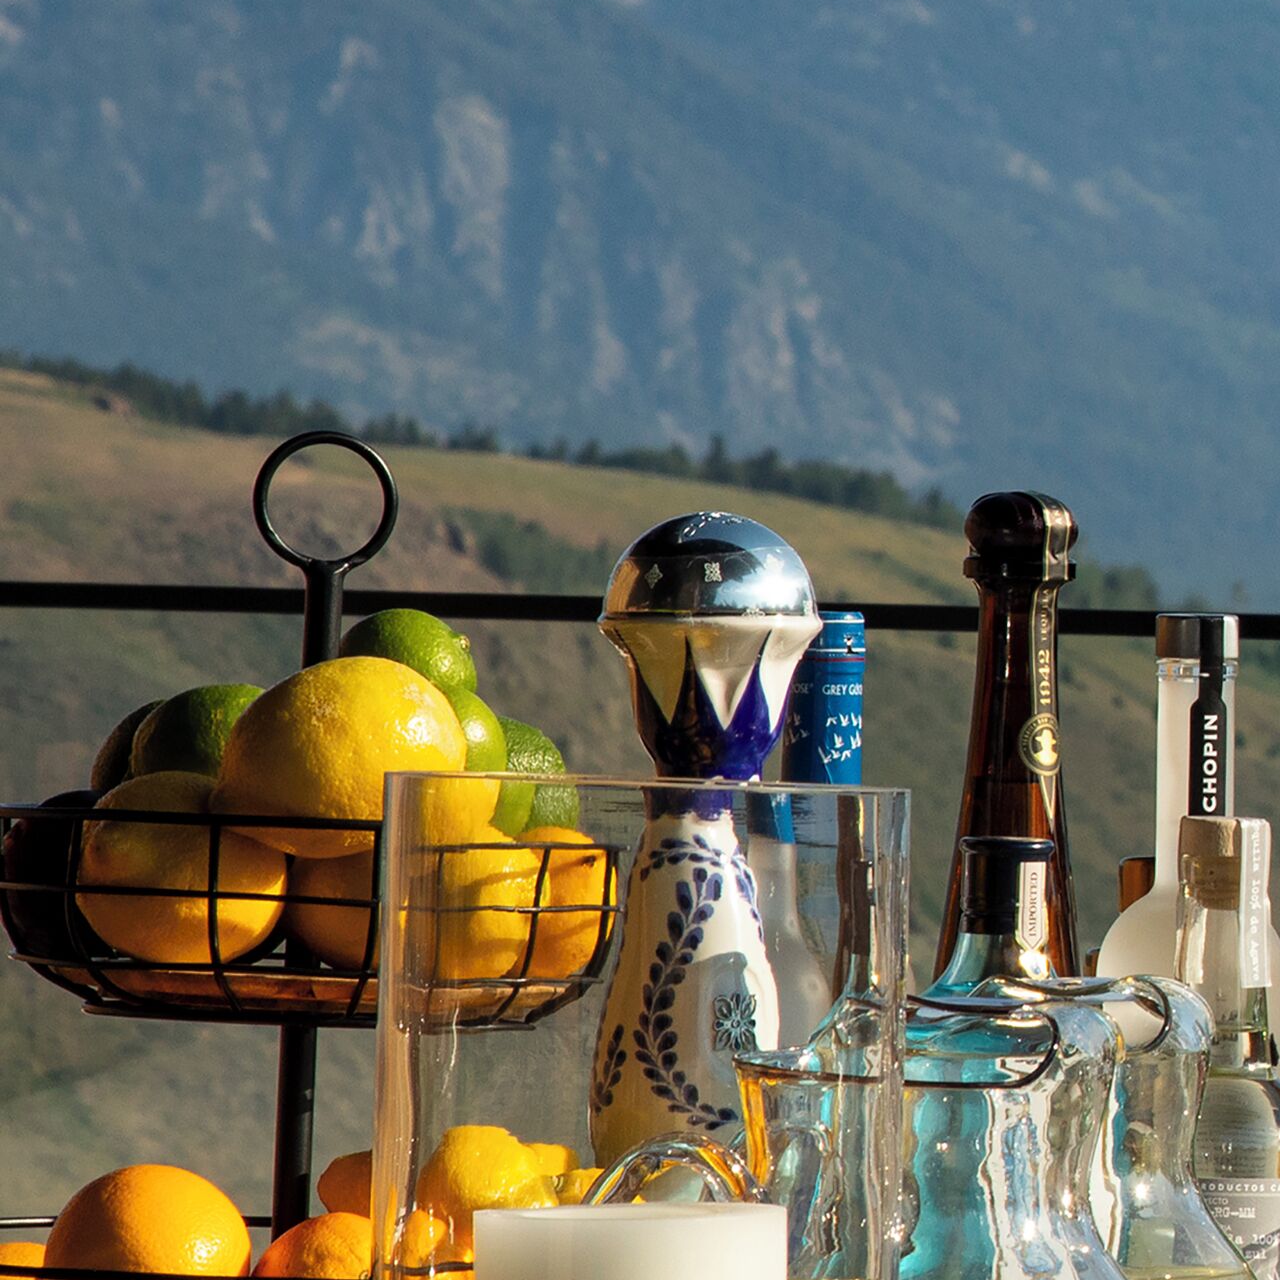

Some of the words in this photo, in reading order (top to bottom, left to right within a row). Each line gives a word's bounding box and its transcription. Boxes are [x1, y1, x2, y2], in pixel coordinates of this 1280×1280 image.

[1040, 588, 1050, 641] TEQUILA
[822, 684, 850, 696] GREY
[1038, 648, 1051, 705] 1942
[1202, 715, 1218, 813] CHOPIN
[1028, 871, 1039, 937] IMPORTED
[1249, 880, 1262, 910] 100%
[1249, 941, 1262, 982] Agave
[1202, 1183, 1265, 1192] RODUCTOS
